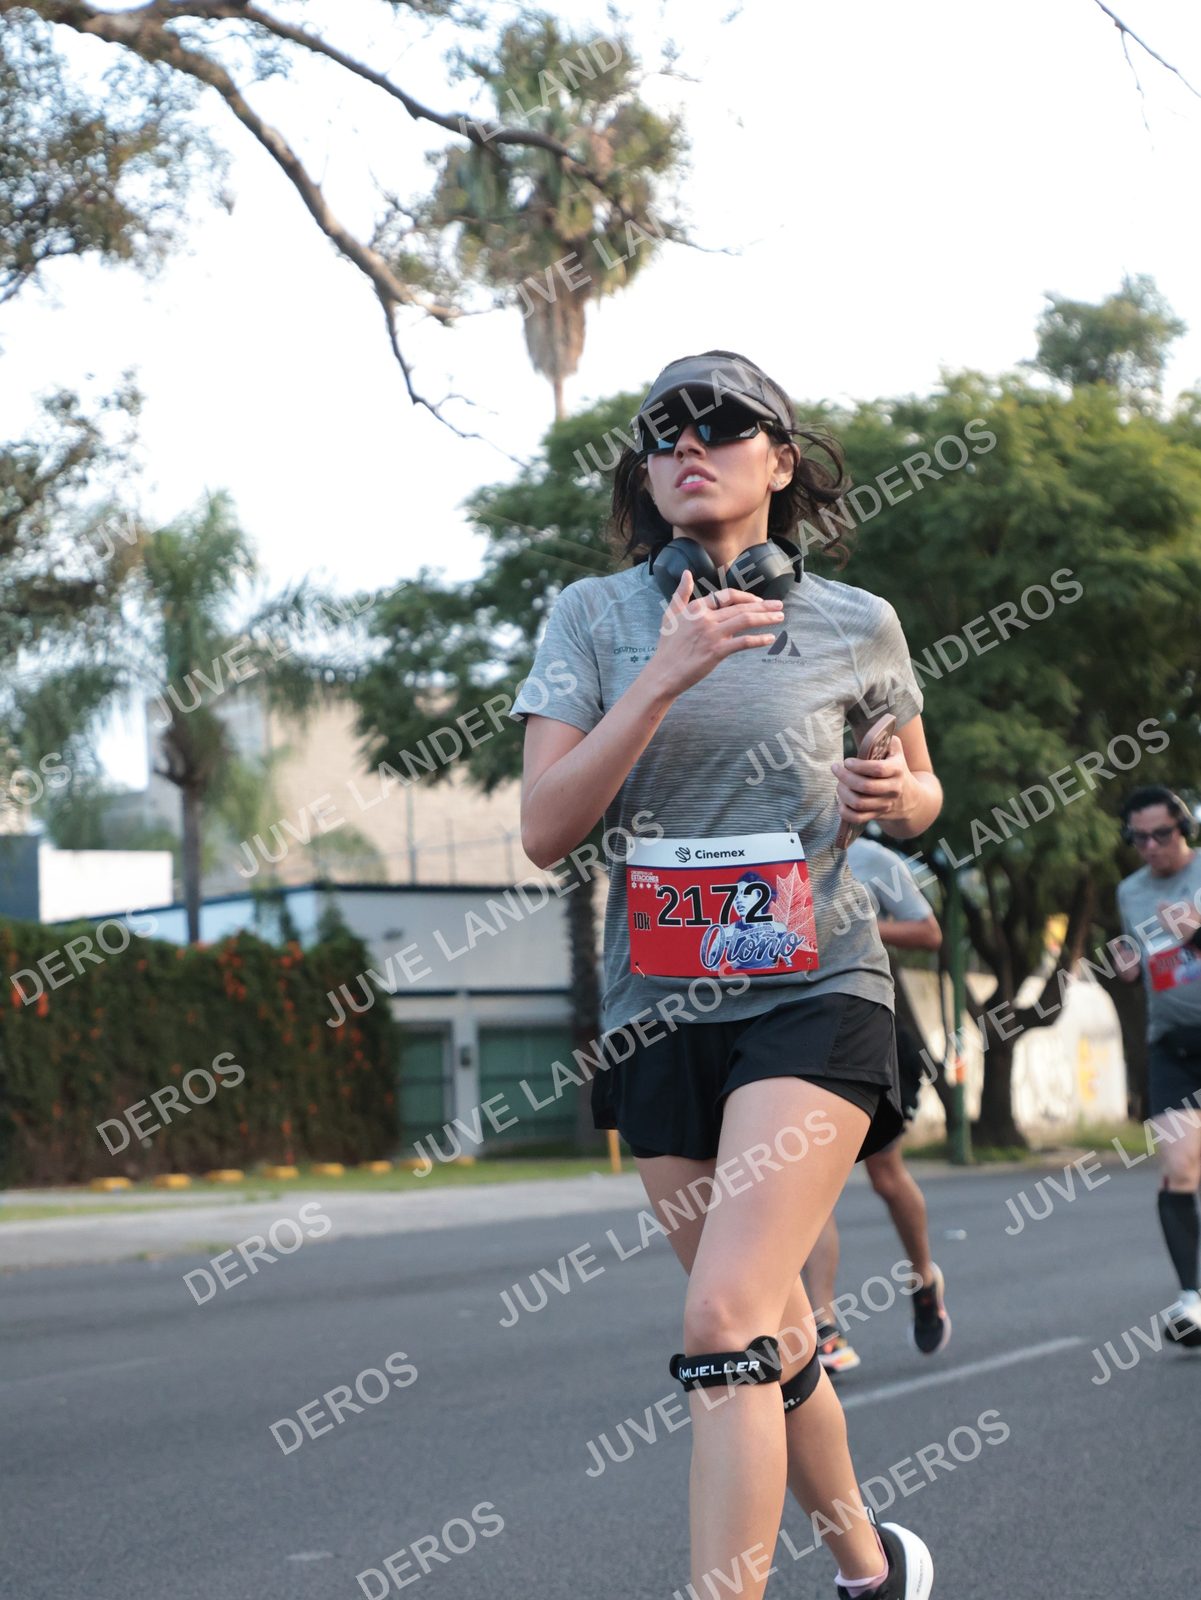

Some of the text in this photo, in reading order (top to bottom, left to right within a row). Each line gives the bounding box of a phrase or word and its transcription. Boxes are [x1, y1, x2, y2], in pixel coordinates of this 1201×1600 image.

[695, 848, 745, 860] Cinemex
[656, 881, 774, 928] 2172
[681, 1361, 760, 1379] MUELLER
